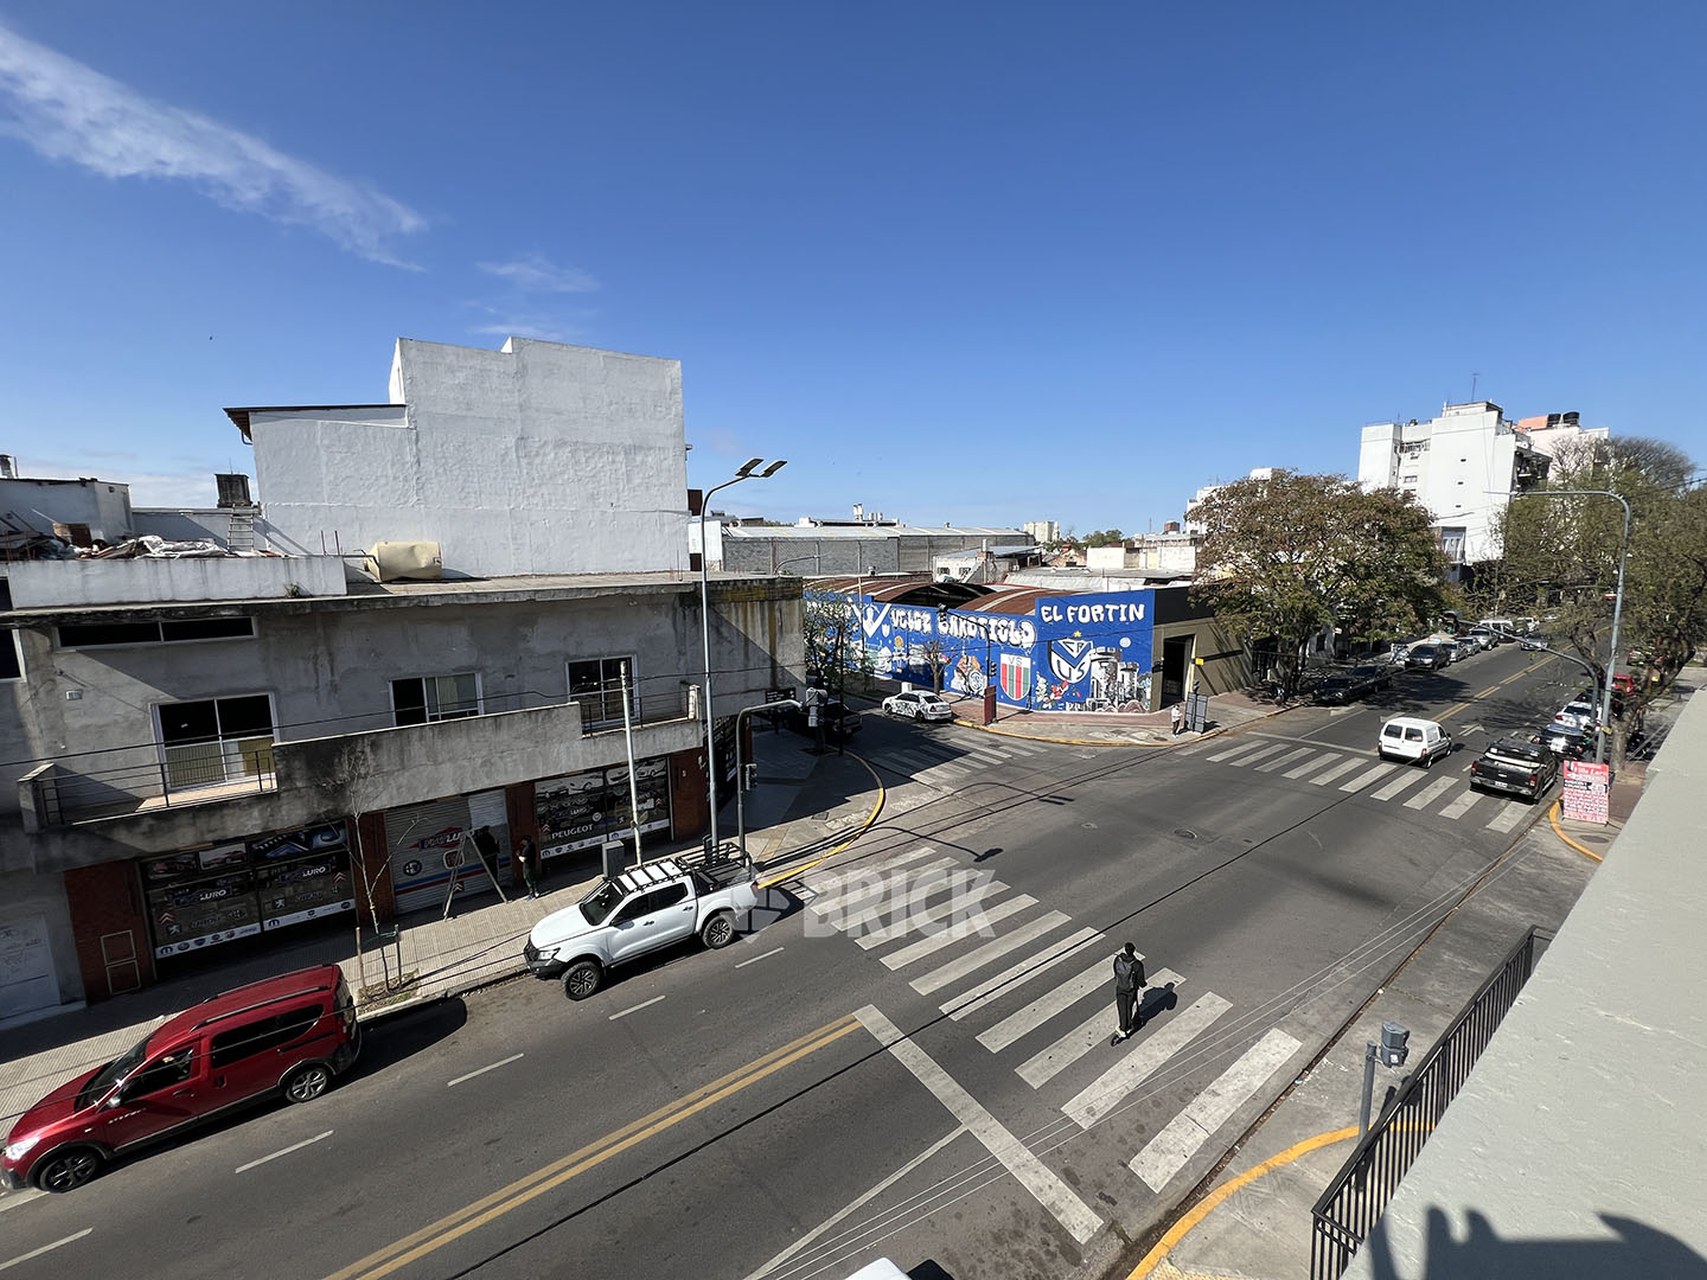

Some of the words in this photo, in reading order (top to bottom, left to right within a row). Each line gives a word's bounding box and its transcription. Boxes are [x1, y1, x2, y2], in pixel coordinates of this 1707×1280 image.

[1040, 605, 1063, 623] EL
[1067, 602, 1145, 623] FORTIN
[1007, 656, 1023, 666] VS
[551, 823, 595, 840] PEUGEOT
